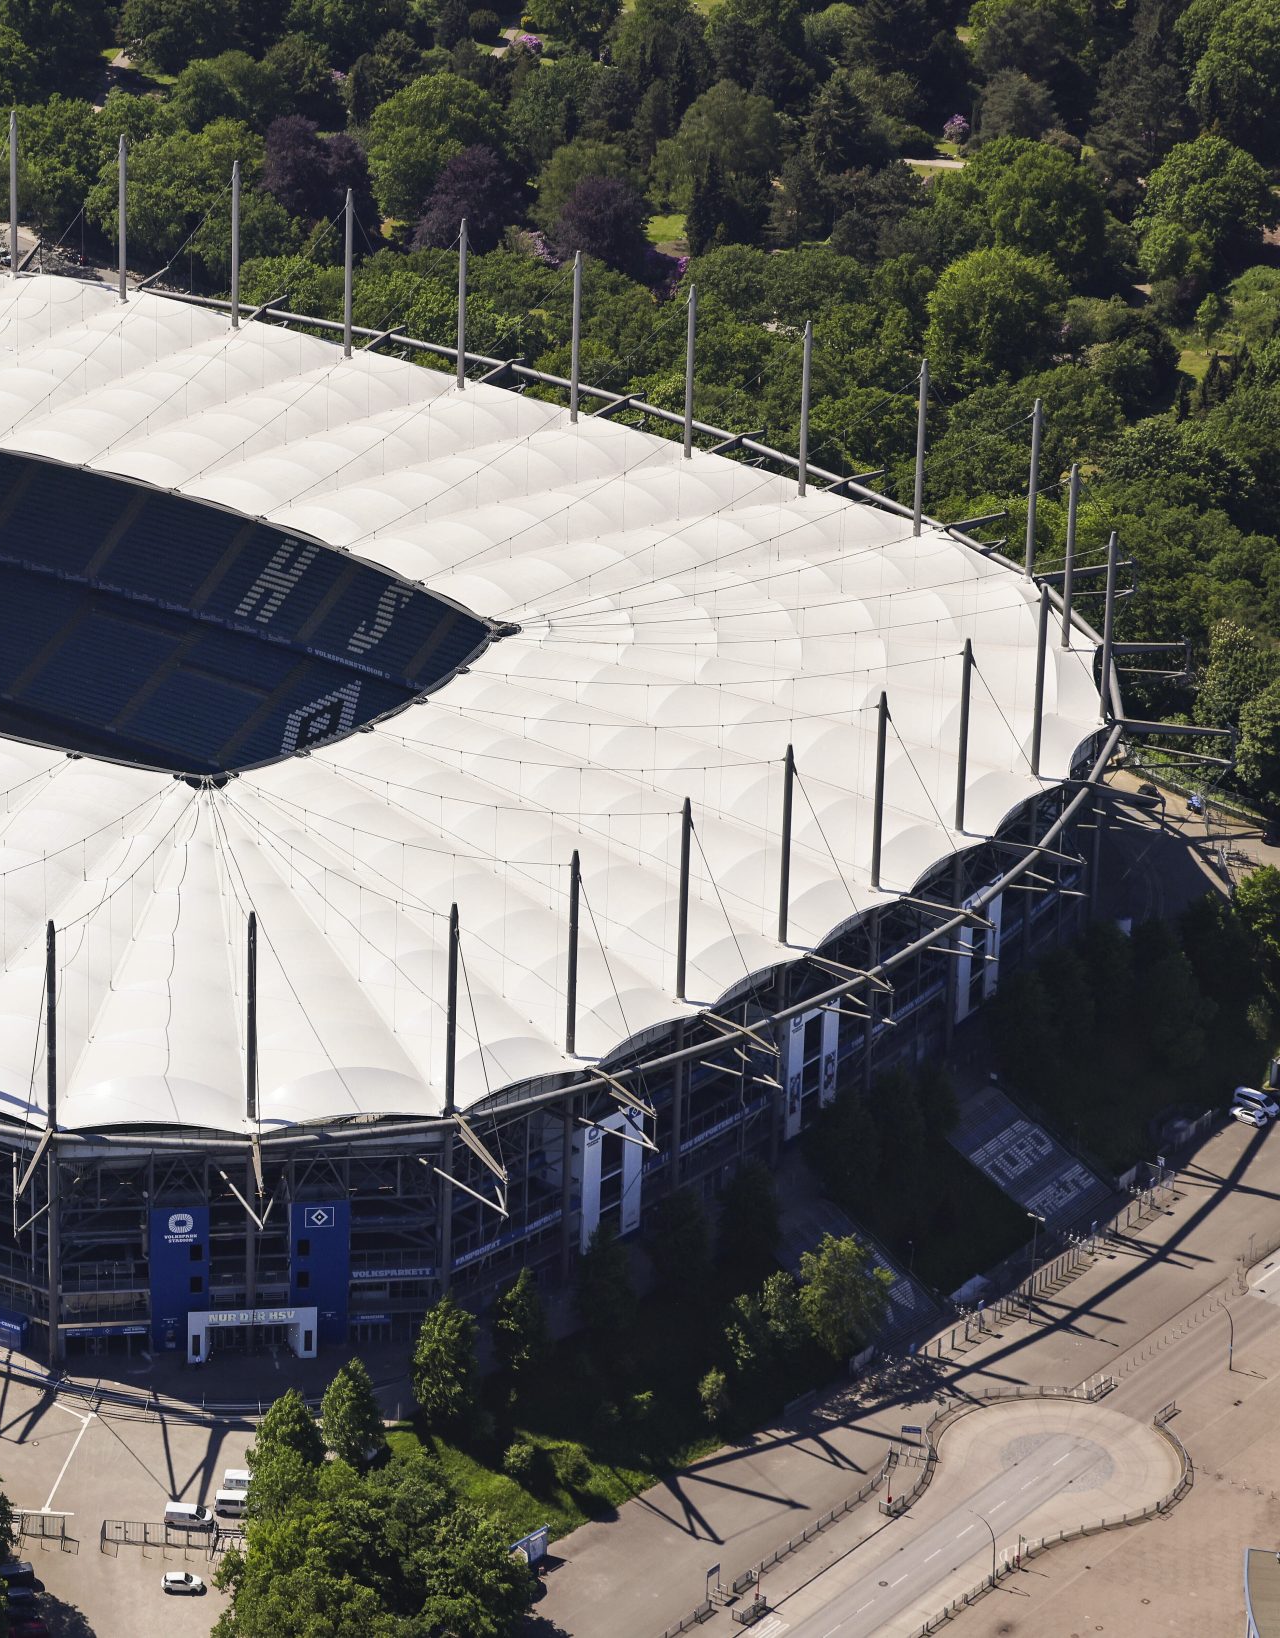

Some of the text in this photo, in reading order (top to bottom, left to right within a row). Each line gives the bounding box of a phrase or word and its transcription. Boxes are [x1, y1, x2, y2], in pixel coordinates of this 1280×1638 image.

[455, 1239, 501, 1266] FANPROJEKT
[351, 1268, 432, 1278] VOLKSPARKETT
[208, 1310, 296, 1323] NUR DER HSV
